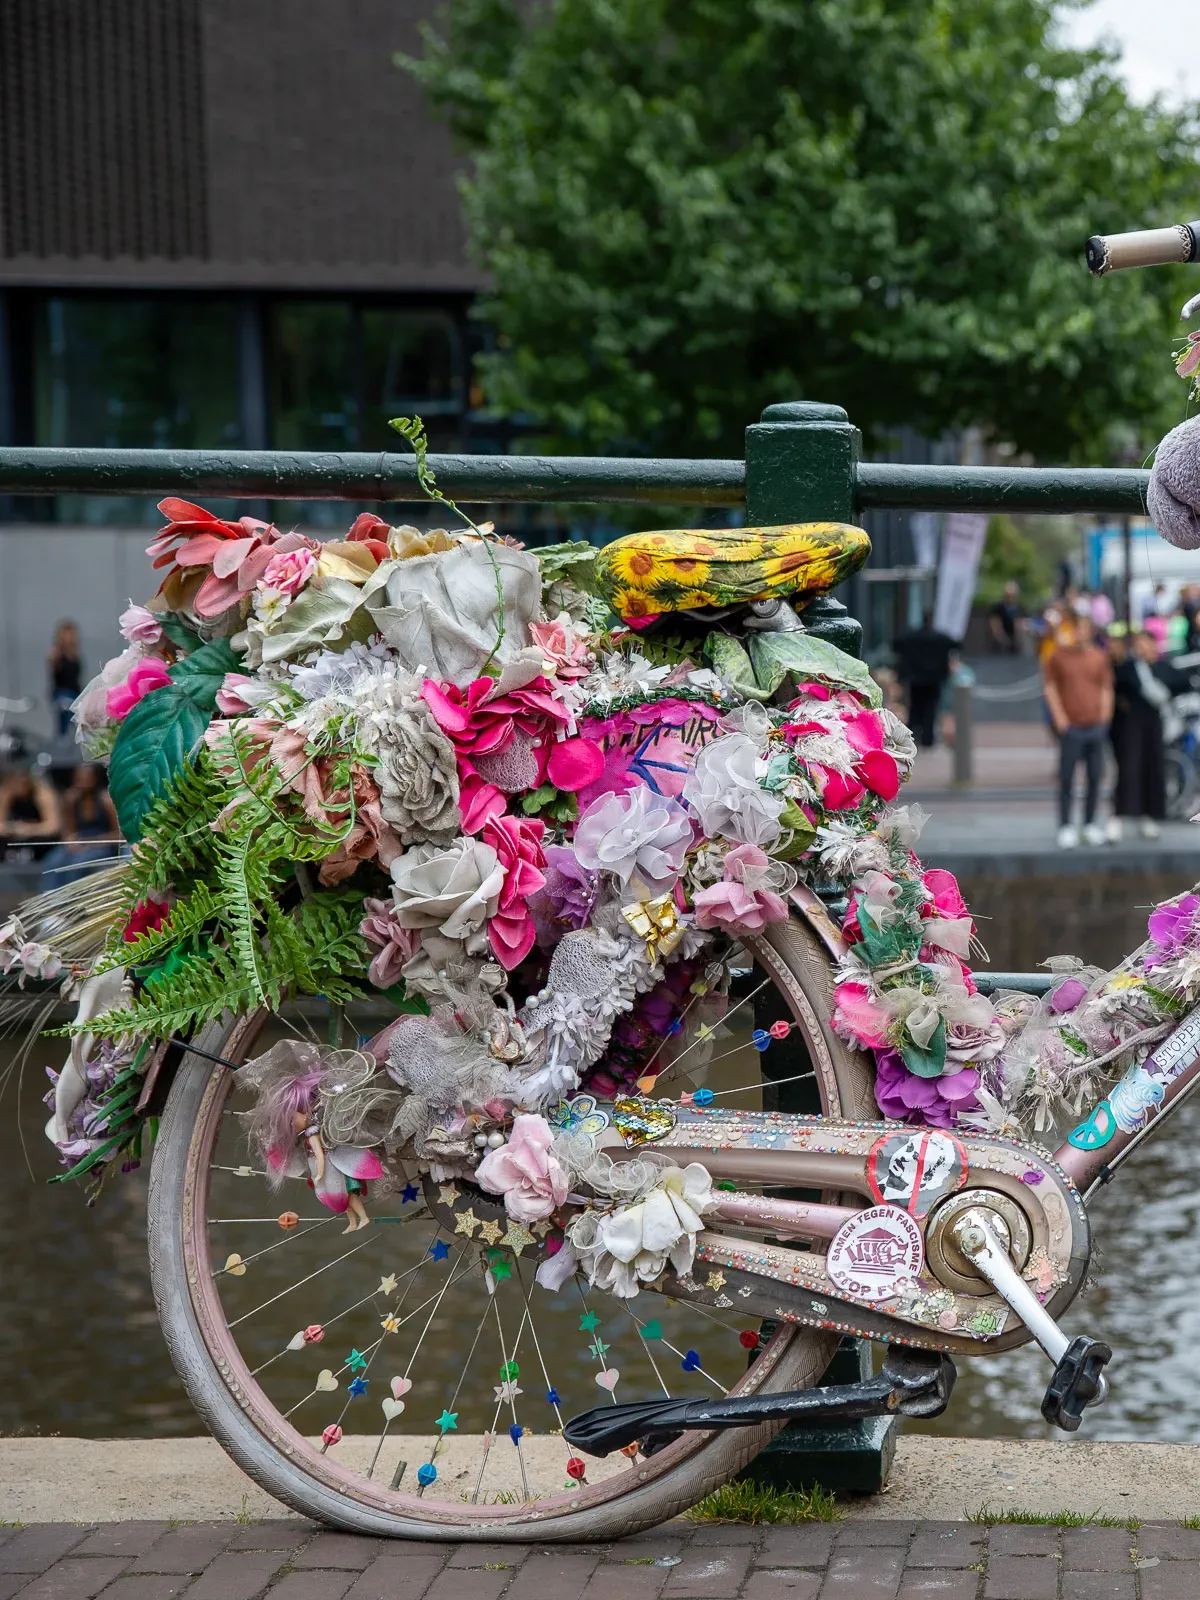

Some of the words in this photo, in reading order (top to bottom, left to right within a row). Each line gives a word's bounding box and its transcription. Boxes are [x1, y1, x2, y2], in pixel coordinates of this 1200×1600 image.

[831, 1223, 856, 1261] SAMEN
[856, 1208, 895, 1224] TEGEN
[895, 1213, 920, 1272] FASCISME
[833, 1270, 871, 1296] STOP
